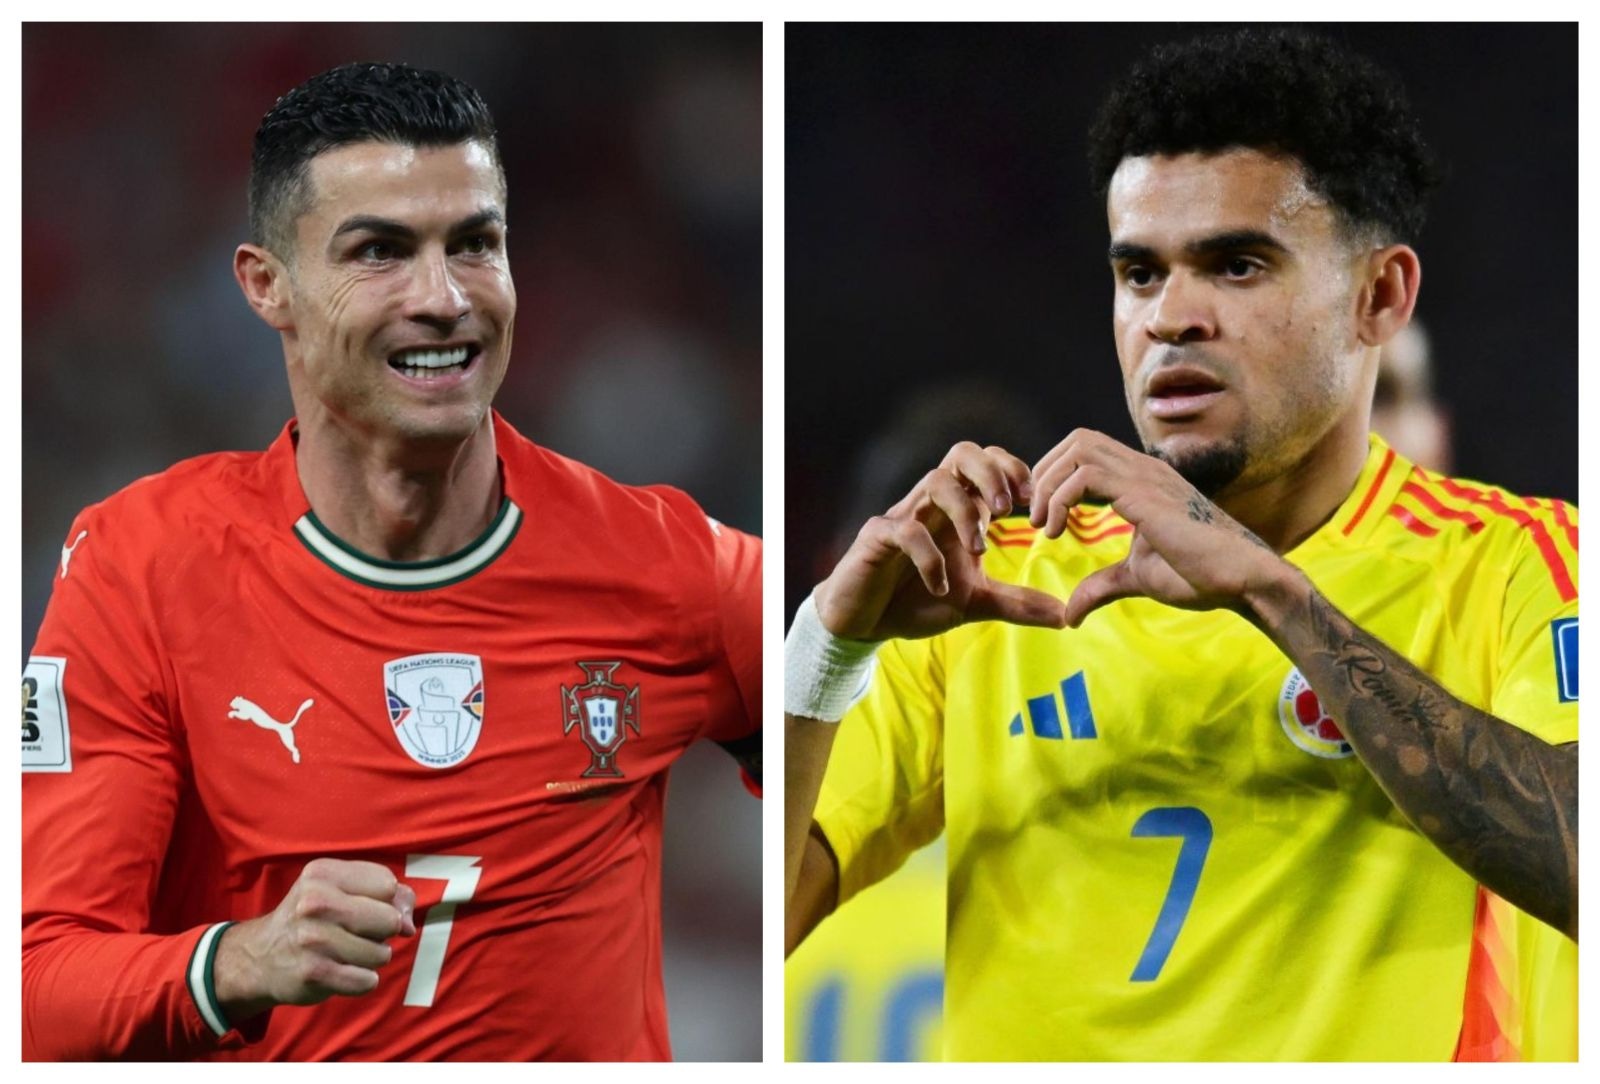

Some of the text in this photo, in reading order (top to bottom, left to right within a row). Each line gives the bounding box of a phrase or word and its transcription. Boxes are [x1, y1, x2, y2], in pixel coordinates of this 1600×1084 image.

[389, 658, 476, 673] UEFA NATIONS LEAGUE
[404, 854, 483, 1008] 7
[1129, 806, 1214, 982] 7
